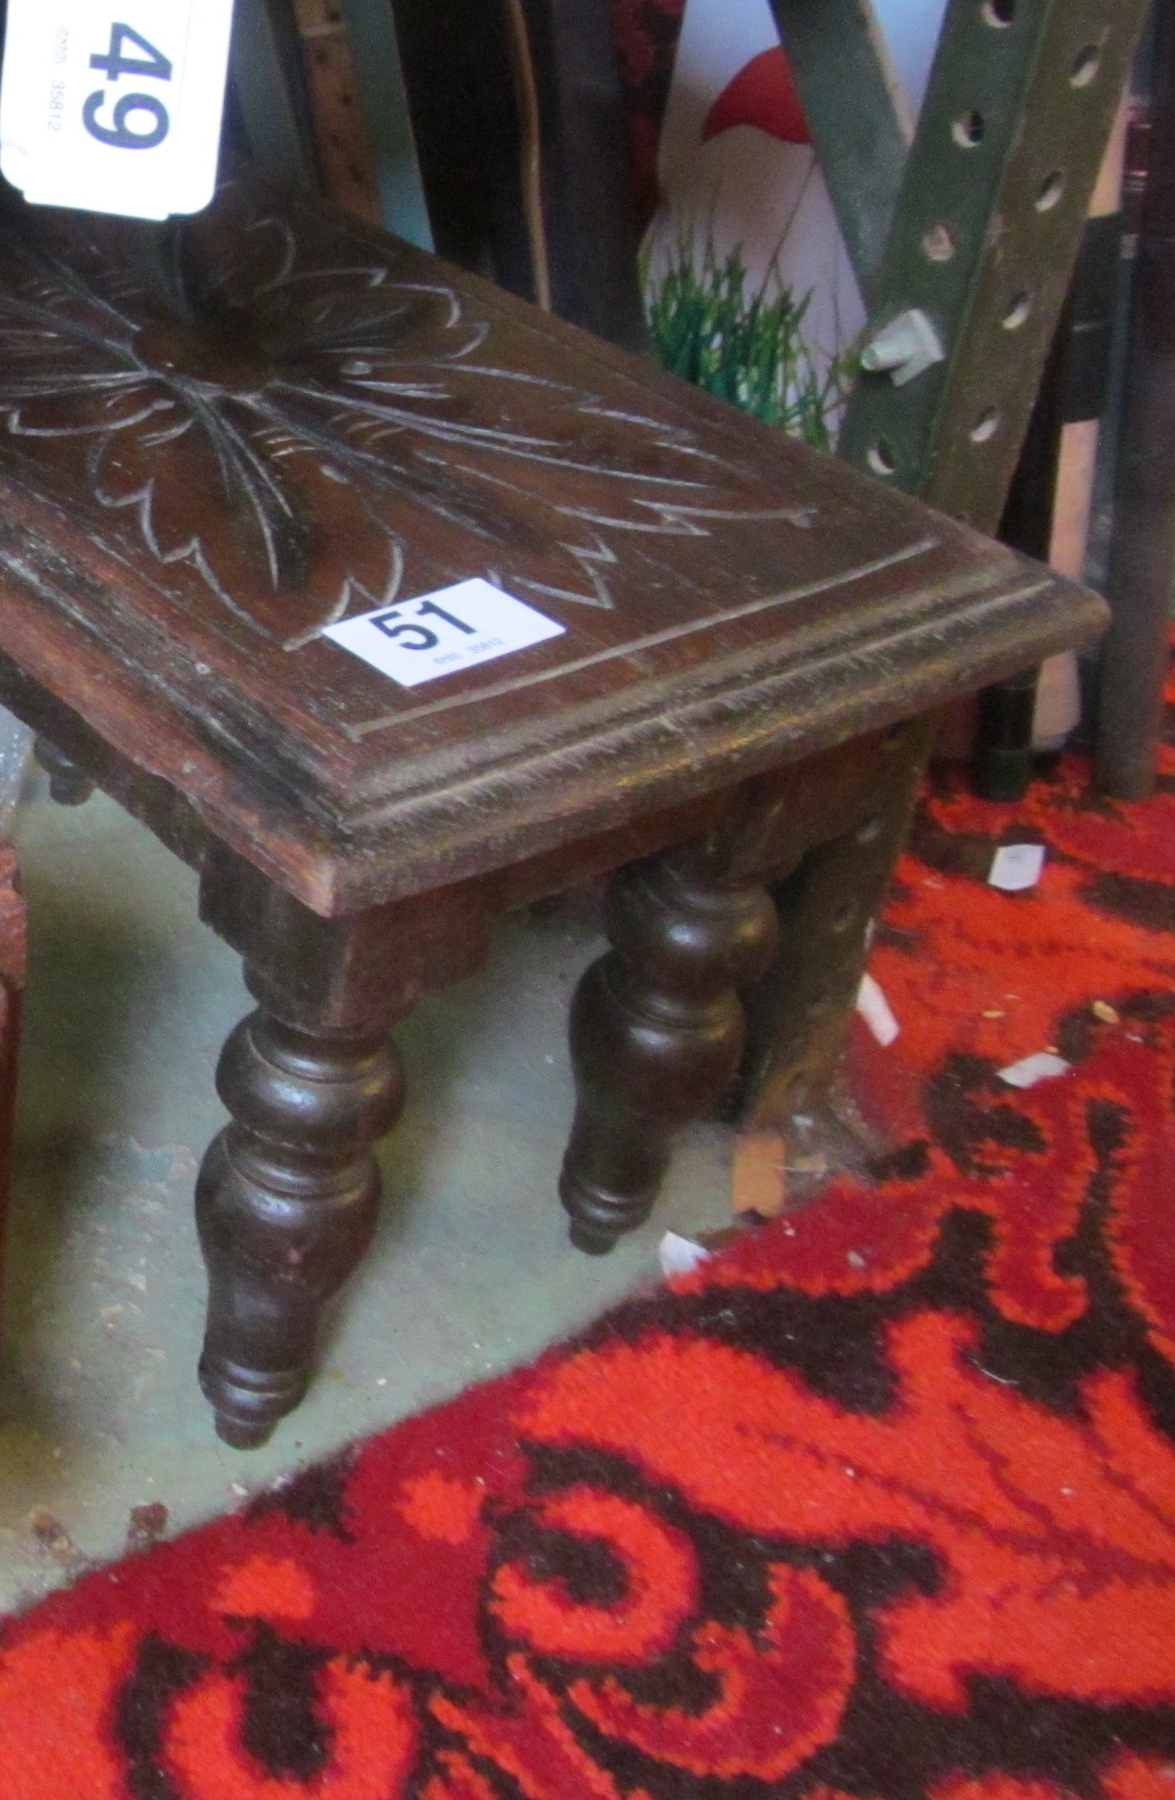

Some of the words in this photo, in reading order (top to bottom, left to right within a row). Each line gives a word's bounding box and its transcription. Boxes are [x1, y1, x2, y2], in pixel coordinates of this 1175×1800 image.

[47, 79, 66, 132] 35812
[82, 21, 173, 150] 49
[368, 600, 477, 651] 51
